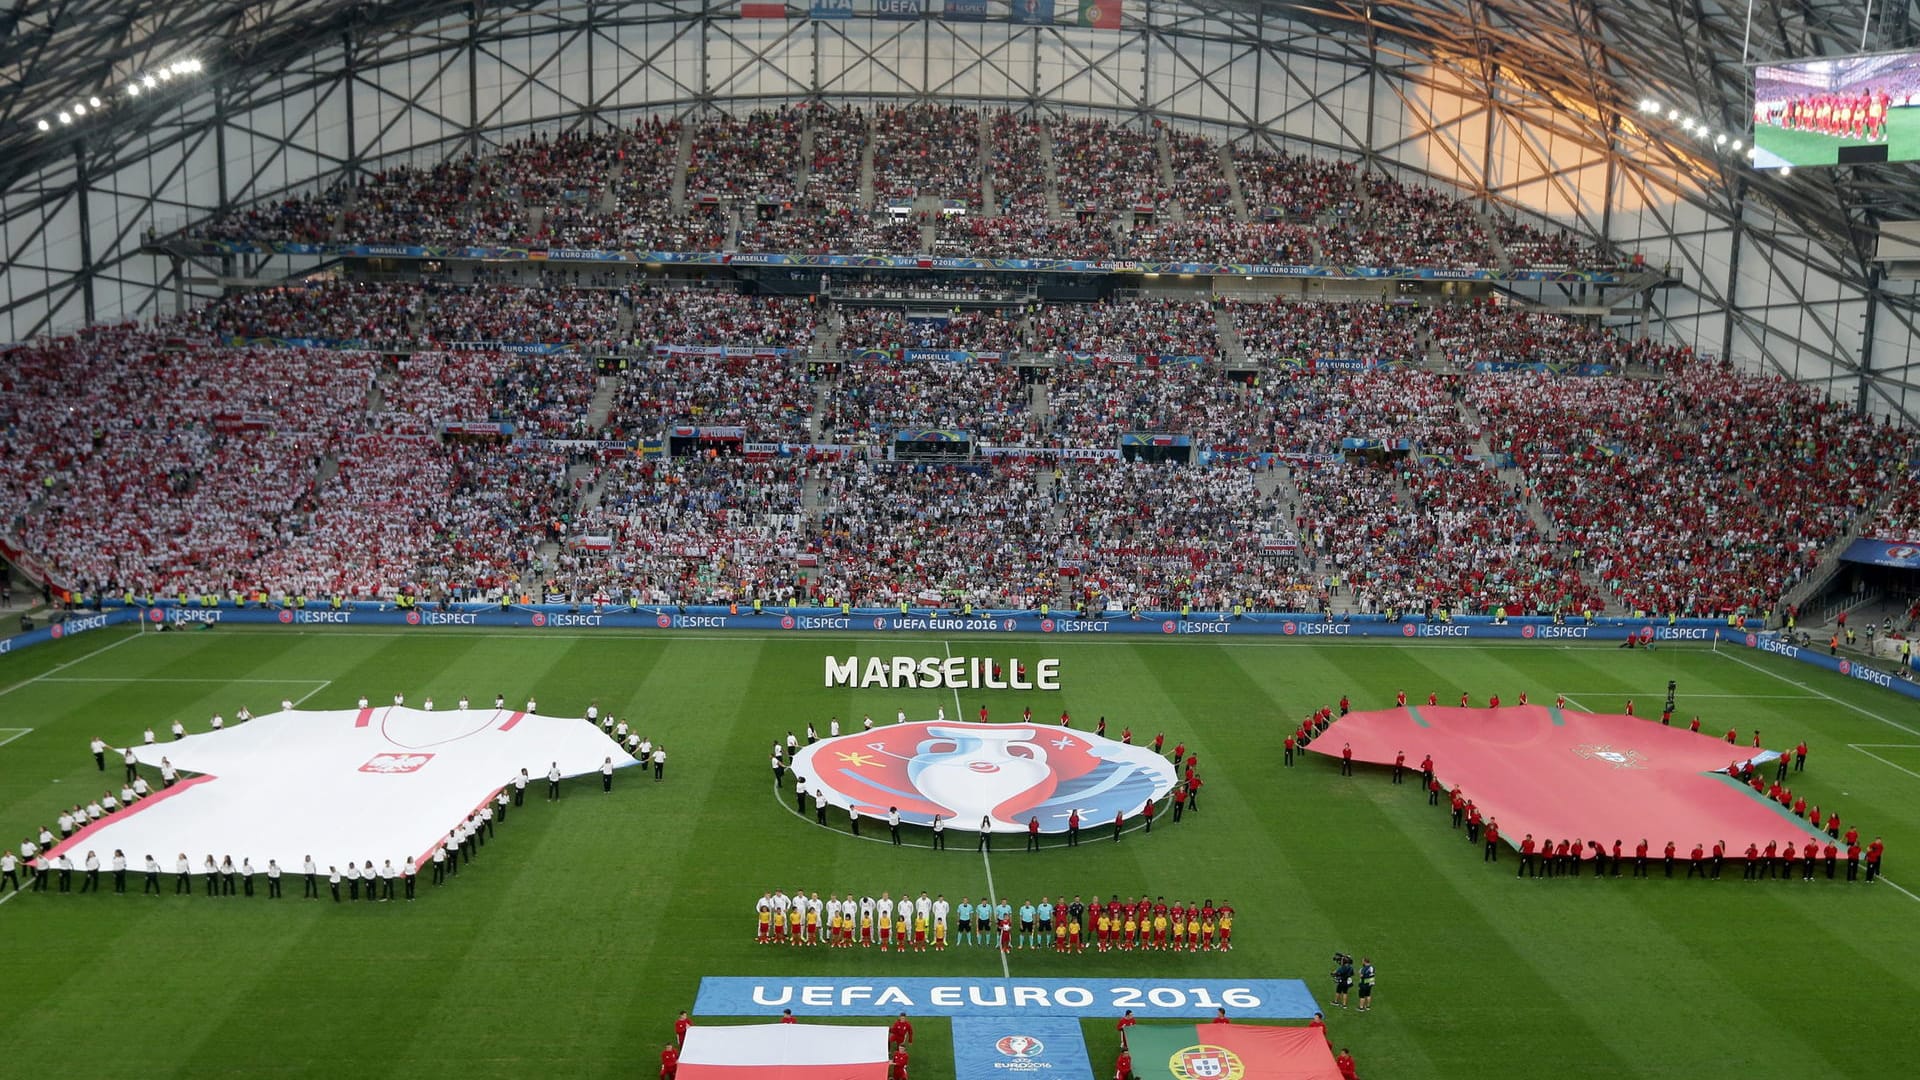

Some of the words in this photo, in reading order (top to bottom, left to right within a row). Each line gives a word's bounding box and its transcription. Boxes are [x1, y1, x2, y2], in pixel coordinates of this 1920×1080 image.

[880, 0, 919, 15] UEFA
[598, 441, 625, 449] KONIN
[167, 608, 222, 622] RESPECT
[295, 609, 350, 624] RESPECT
[422, 610, 477, 625] RESPECT
[548, 612, 602, 627] RESPECT
[673, 614, 727, 628] RESPECT
[797, 615, 851, 630] RESPECT
[64, 614, 107, 635] RESPECT
[893, 619, 927, 629] UEFA
[929, 619, 963, 630] EURO
[966, 619, 997, 630] 2016
[1056, 619, 1110, 633] RESPECT
[1178, 619, 1231, 634] RESPECT
[1298, 621, 1351, 635] RESPECT
[1417, 623, 1470, 637] RESPECT
[1536, 624, 1588, 639] RESPECT
[1656, 625, 1708, 640] RESPECT
[1757, 635, 1799, 659] RESPECT
[825, 655, 1061, 690] MARSEILLE
[1850, 661, 1893, 689] RESPECT
[752, 985, 915, 1007] UEFA
[930, 986, 1093, 1008] EURO
[1110, 986, 1262, 1009] 2016
